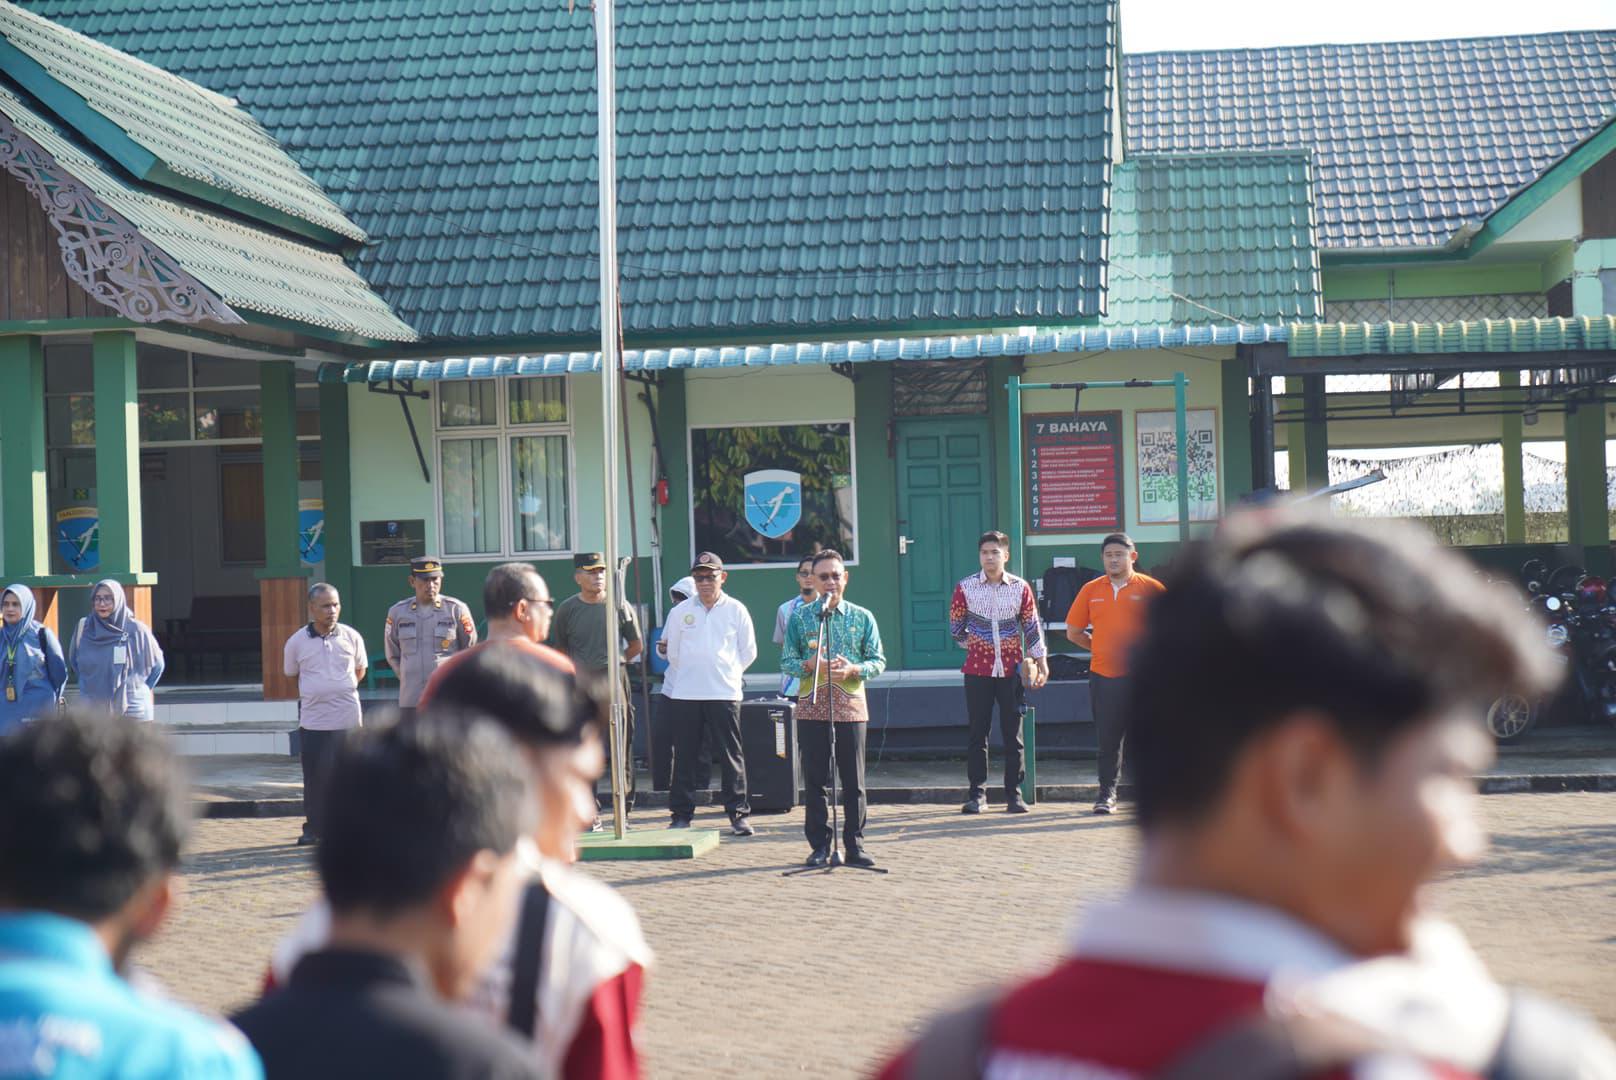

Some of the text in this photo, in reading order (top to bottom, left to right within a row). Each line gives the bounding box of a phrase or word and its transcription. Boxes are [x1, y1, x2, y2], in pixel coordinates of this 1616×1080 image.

[1036, 422, 1108, 434] 7 BAHAYA
[1031, 460, 1037, 468] 2
[1031, 471, 1038, 480] 3
[1032, 484, 1038, 492] 4
[1032, 496, 1039, 504] 5
[1033, 519, 1039, 527] 7
